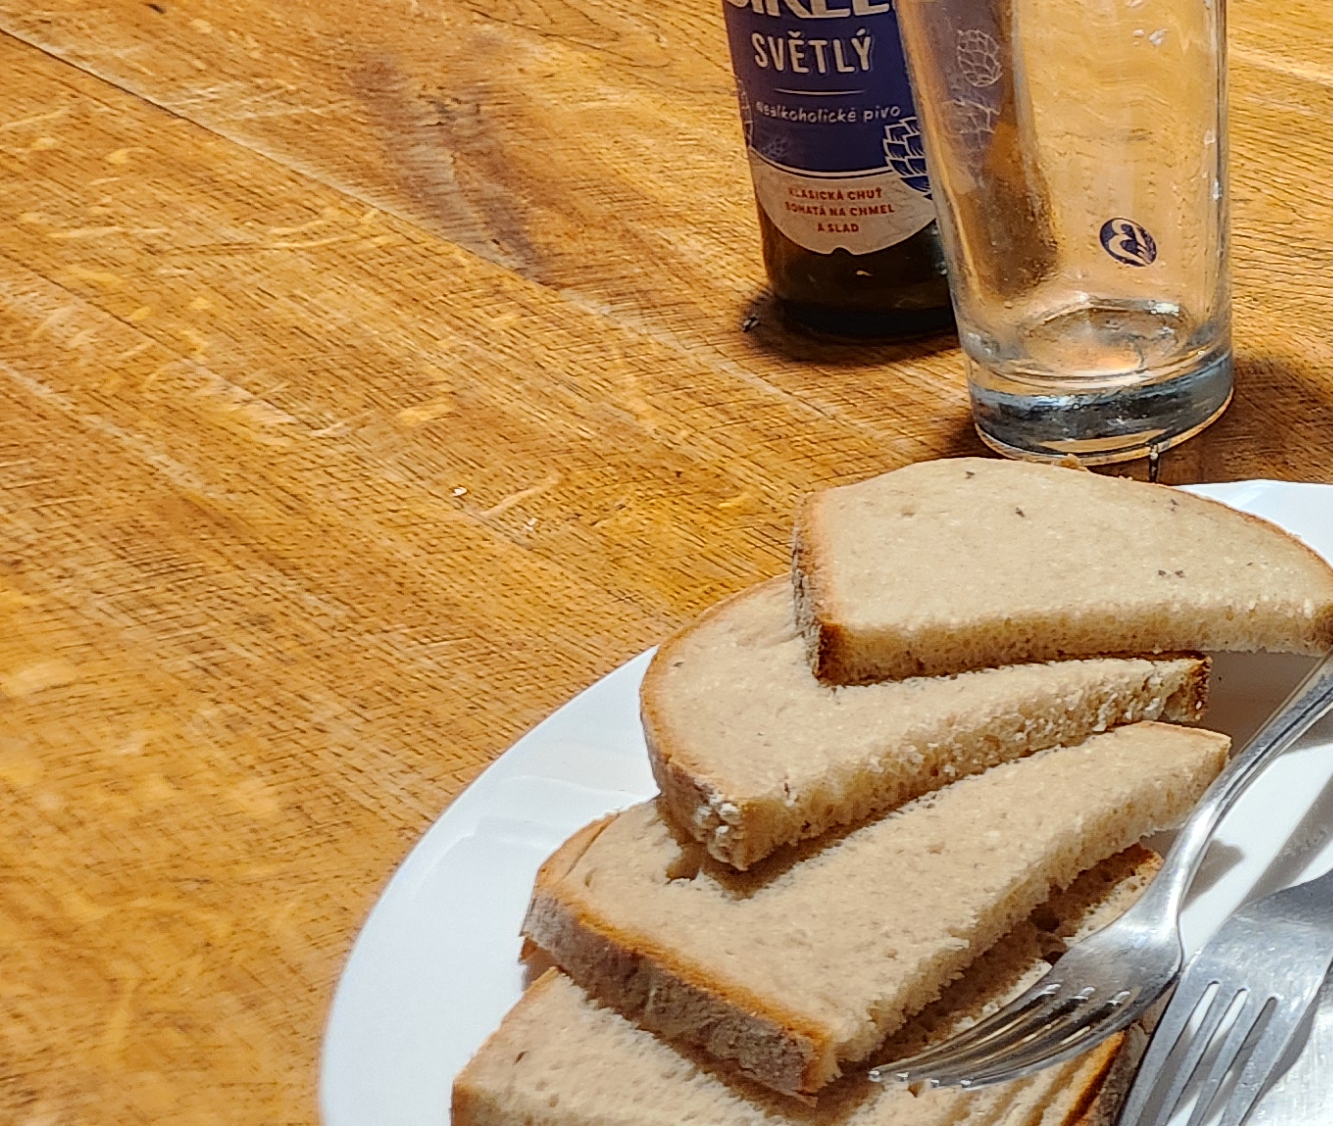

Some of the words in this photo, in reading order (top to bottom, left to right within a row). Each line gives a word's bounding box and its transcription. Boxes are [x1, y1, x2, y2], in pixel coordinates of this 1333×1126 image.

[751, 28, 872, 74] SVĚTLÝ
[863, 104, 901, 123] pivo
[849, 203, 895, 216] CHMEL
[827, 222, 860, 233] SLAD
